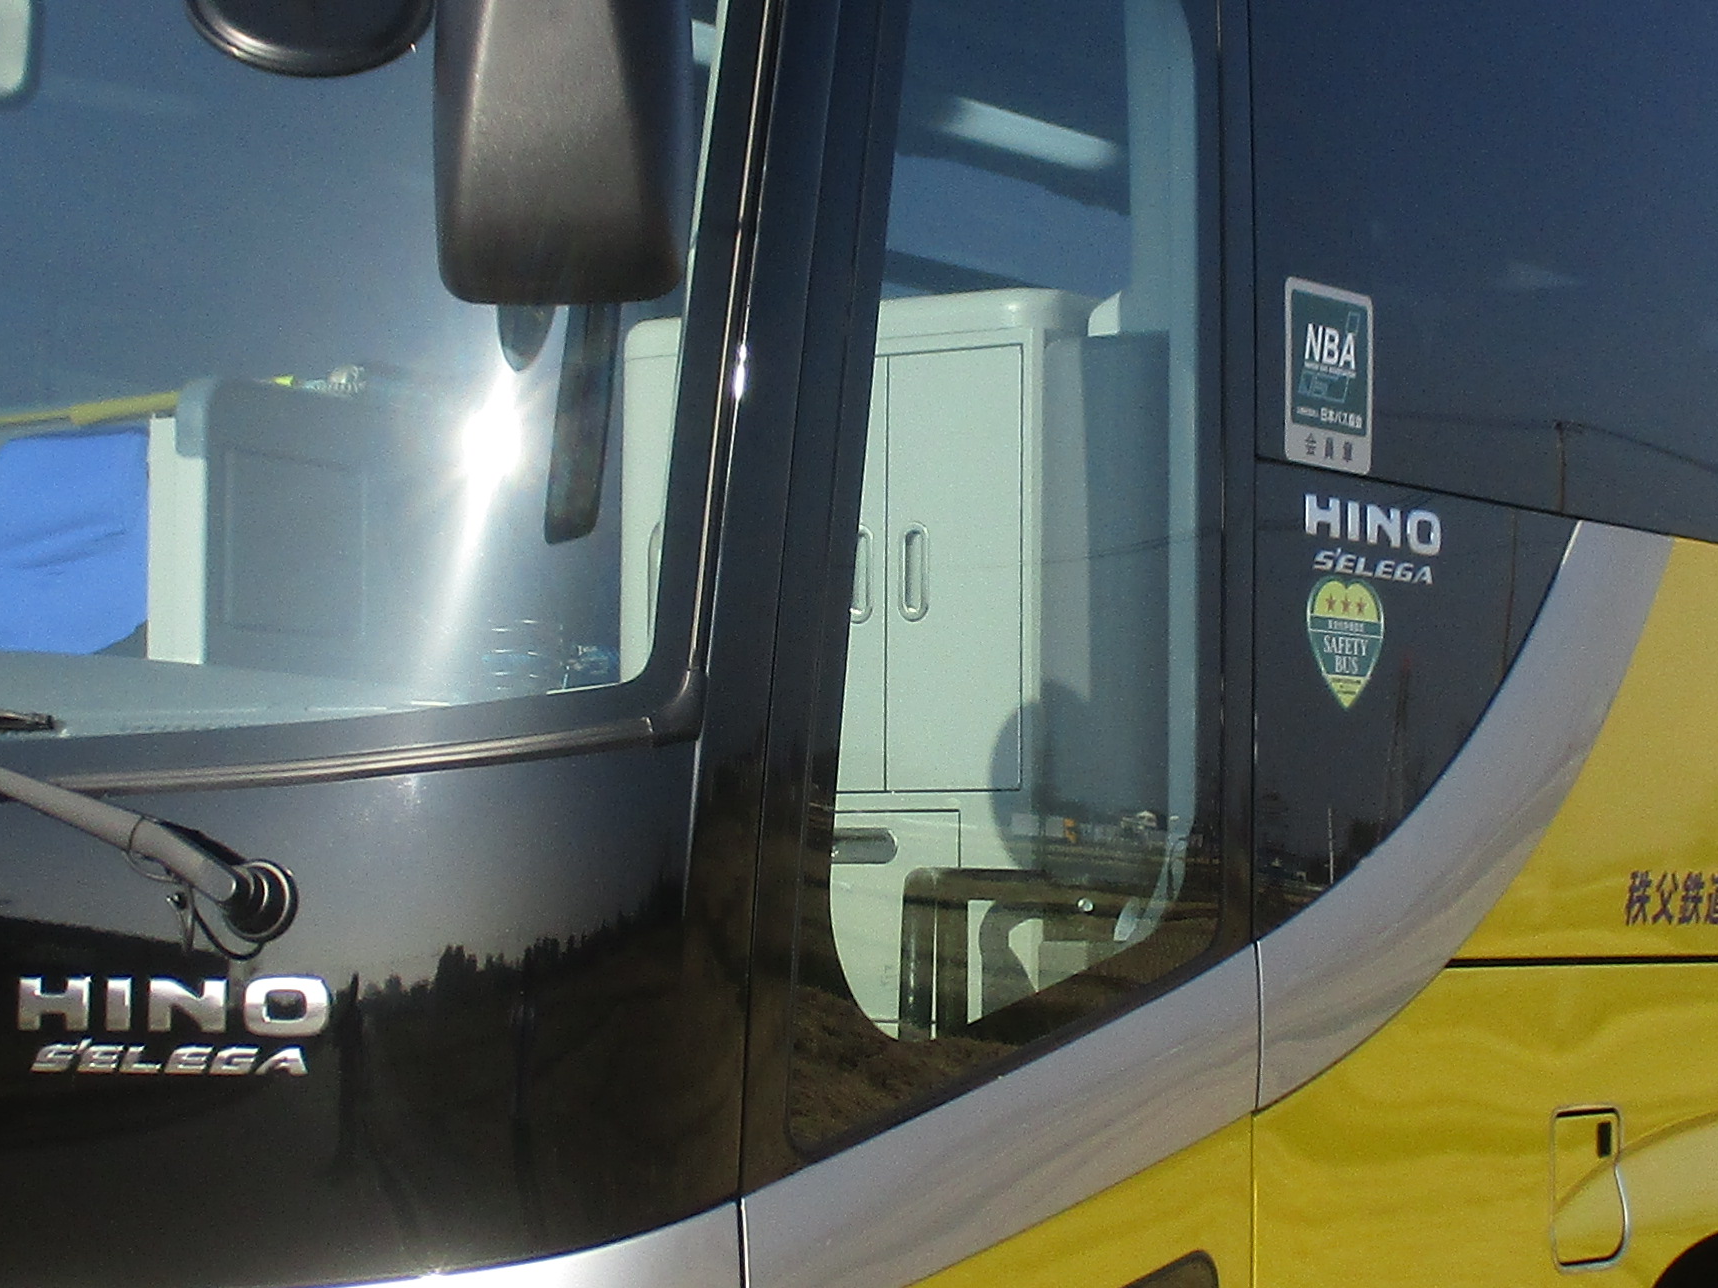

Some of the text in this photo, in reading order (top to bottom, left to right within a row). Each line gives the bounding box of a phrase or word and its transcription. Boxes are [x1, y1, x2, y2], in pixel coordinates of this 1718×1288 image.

[1304, 323, 1356, 370] NBA
[1304, 493, 1442, 556] HINO
[1323, 634, 1369, 657] SAFETY
[1334, 655, 1359, 675] BUS
[16, 974, 332, 1037] HINO
